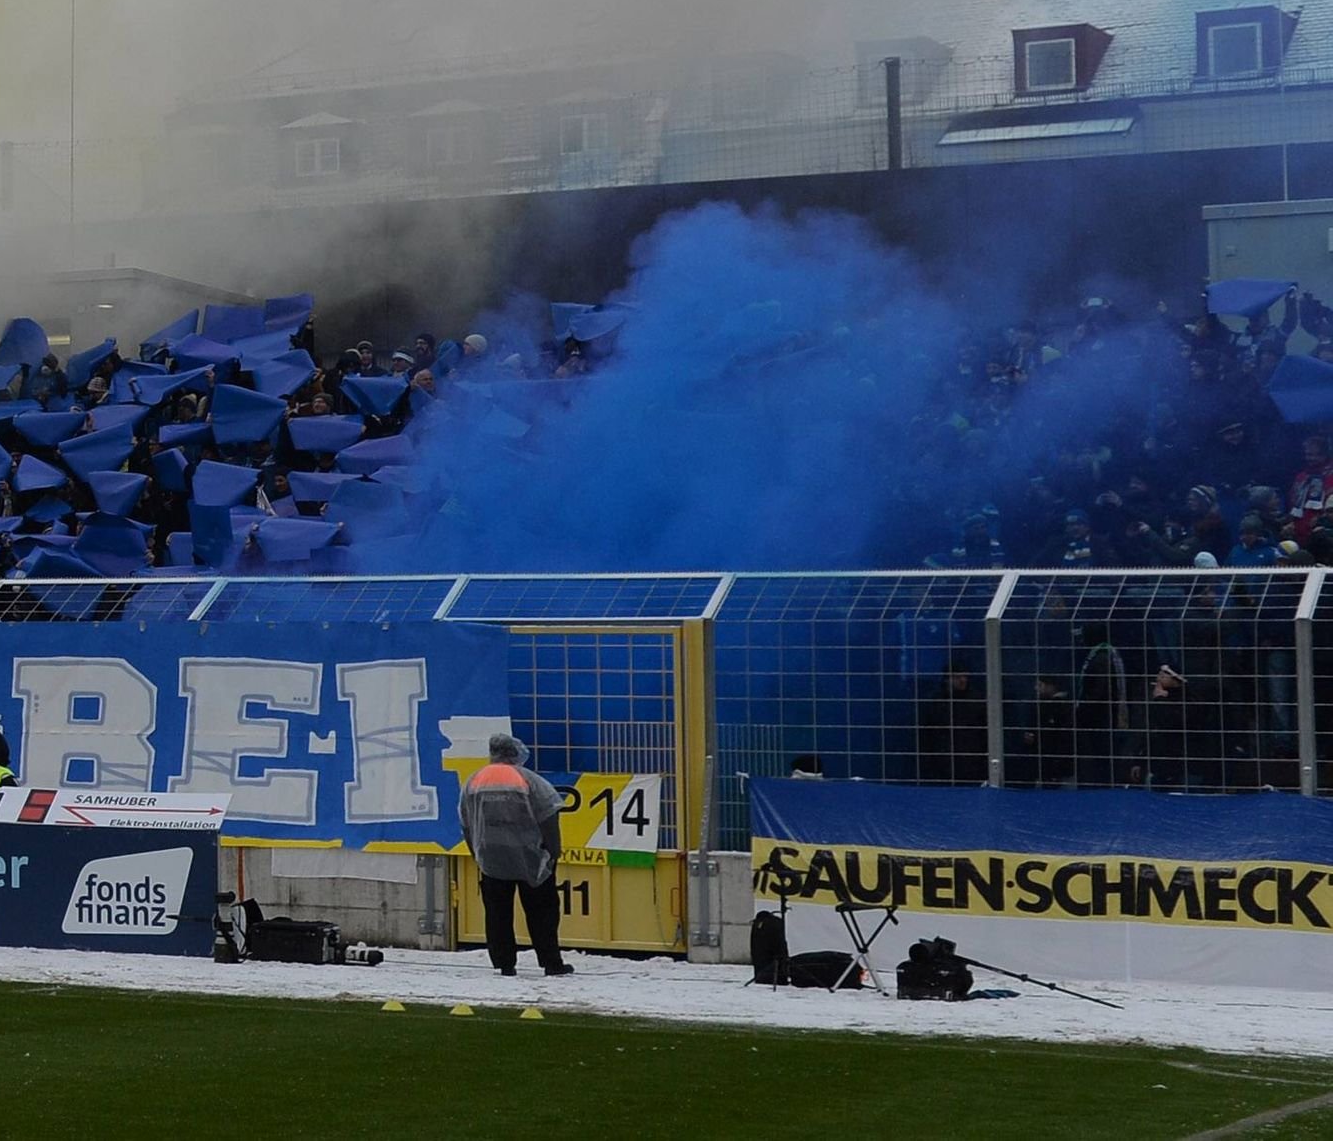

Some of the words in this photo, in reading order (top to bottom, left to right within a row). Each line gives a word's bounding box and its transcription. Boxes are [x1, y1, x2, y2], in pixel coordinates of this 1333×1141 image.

[74, 794, 157, 807] SAMHUBER
[109, 818, 216, 830] Elektro-Installation
[85, 873, 166, 904] fonds
[75, 896, 166, 928] finanz
